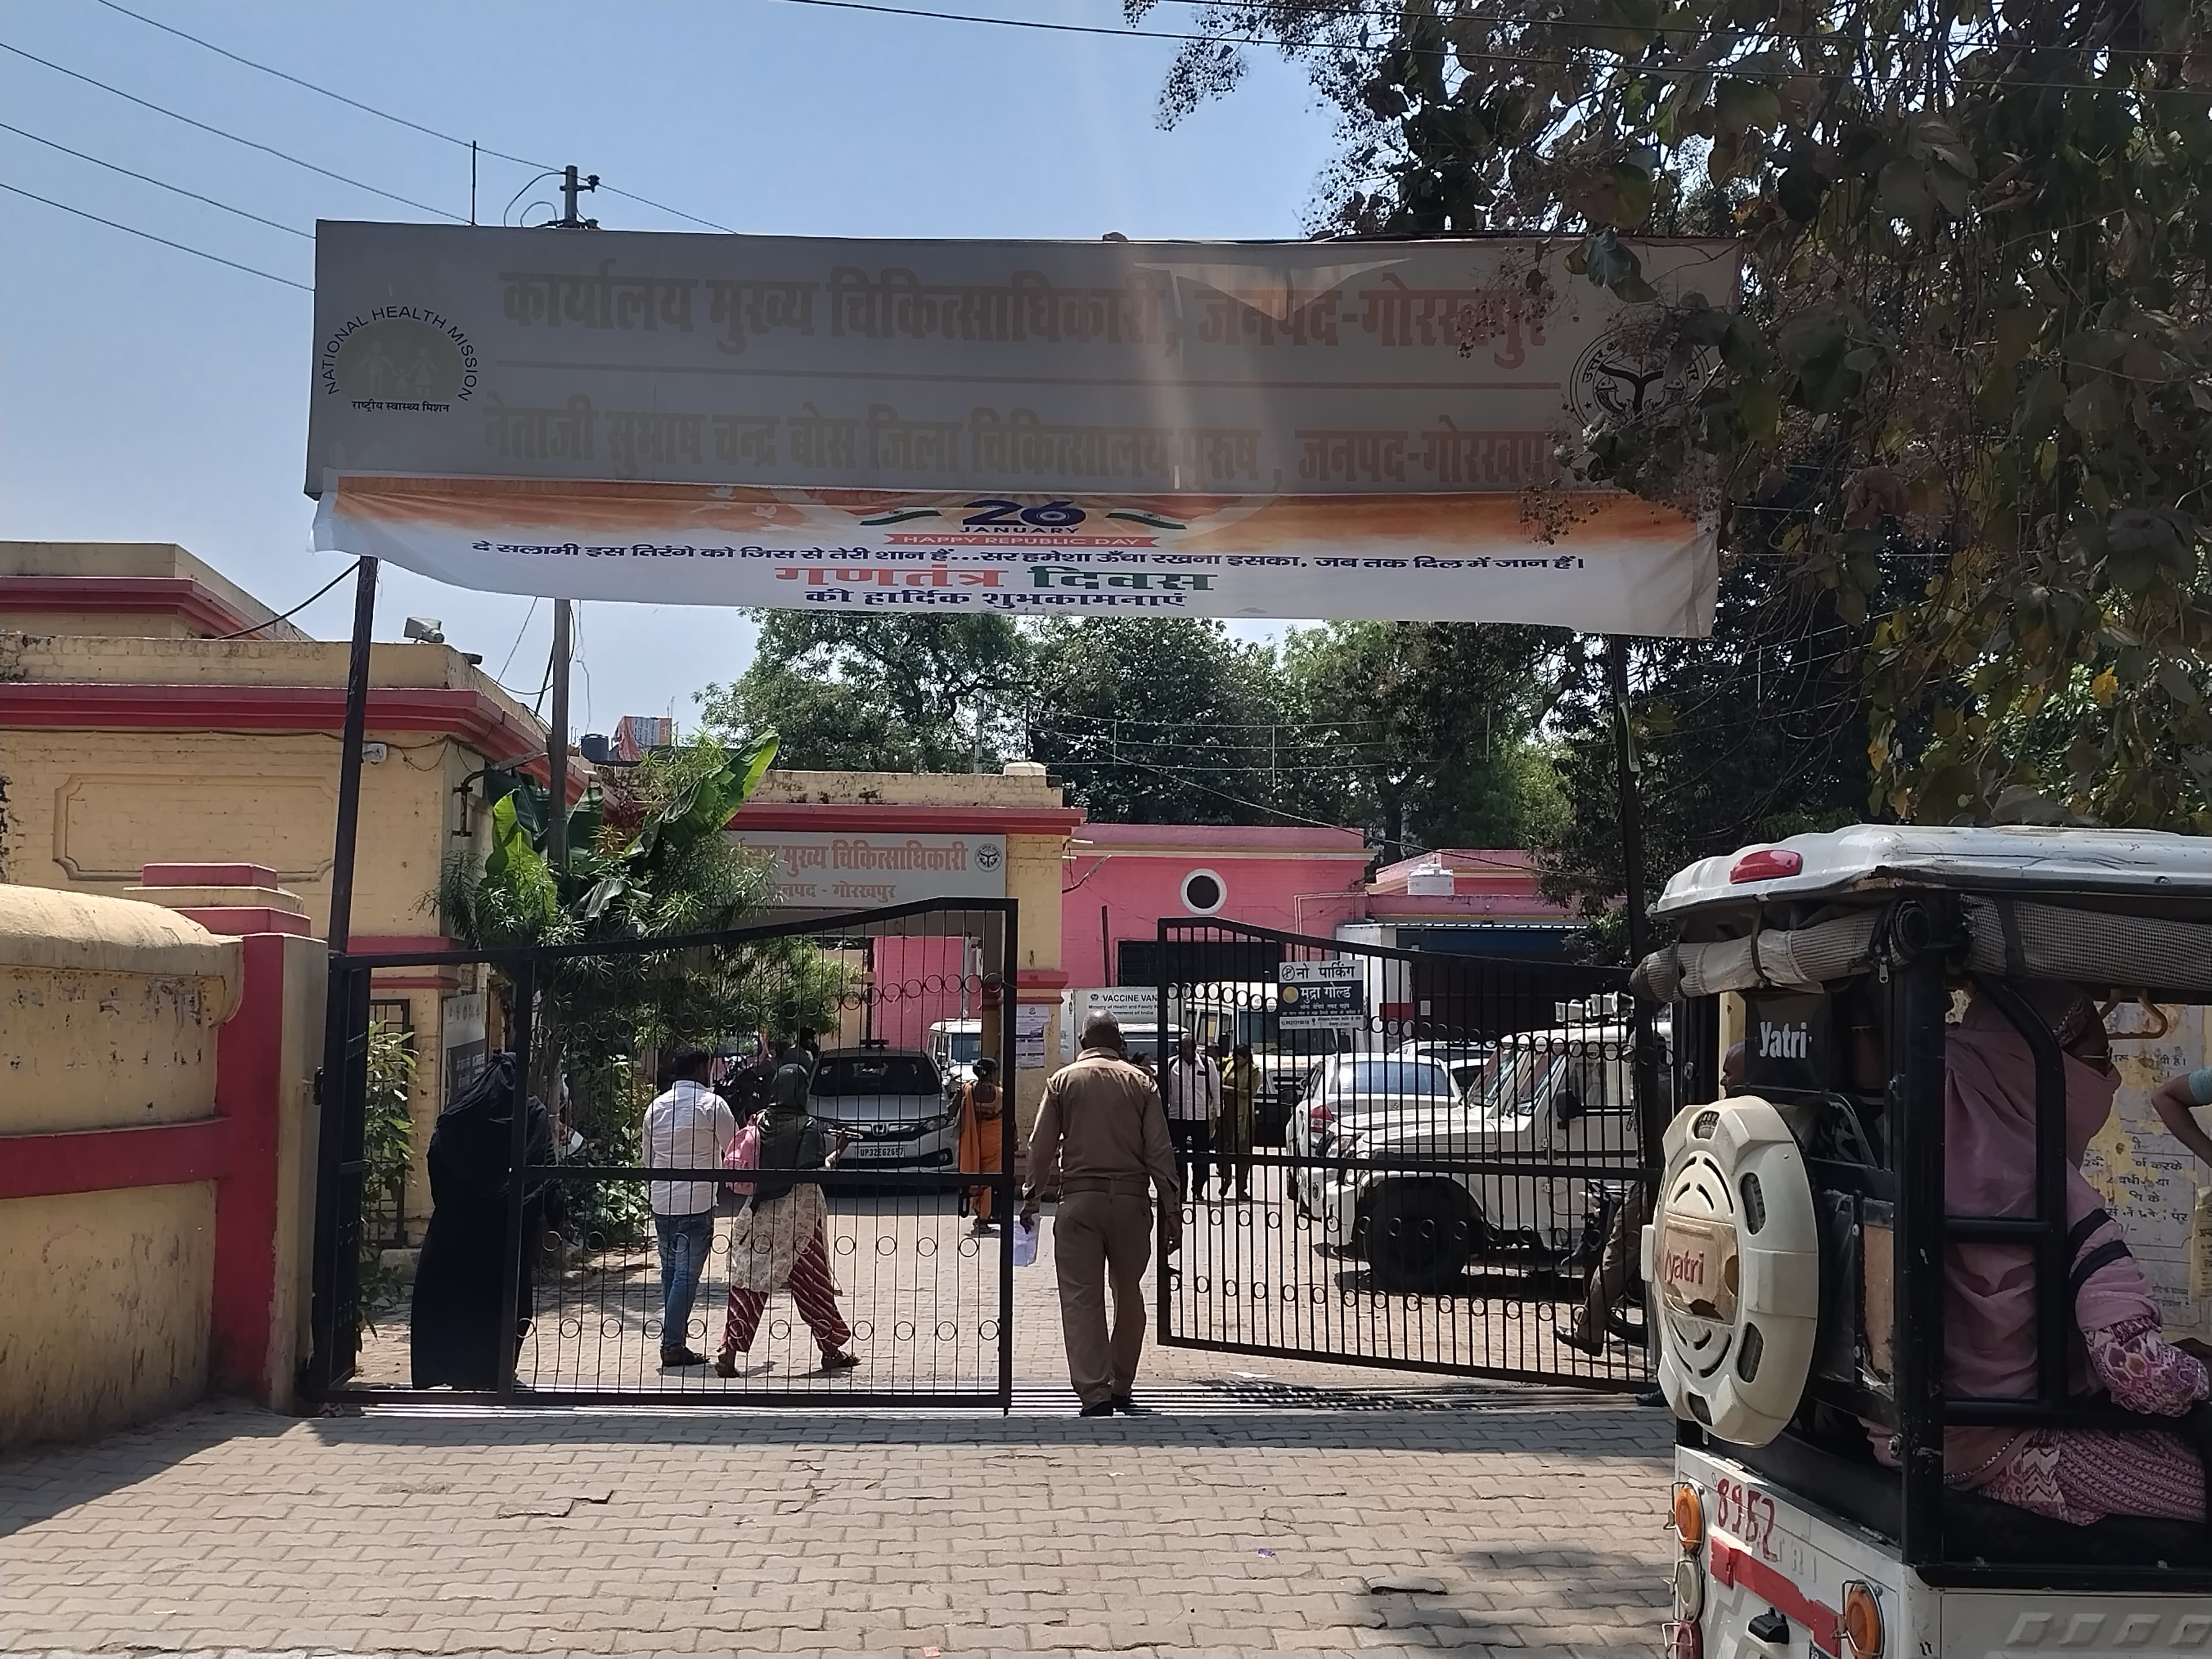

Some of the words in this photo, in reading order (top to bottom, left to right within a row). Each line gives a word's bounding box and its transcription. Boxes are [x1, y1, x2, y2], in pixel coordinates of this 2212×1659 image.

[498, 257, 699, 332] कार्यालय
[704, 278, 820, 355] मुख्य
[321, 315, 369, 396] NATIONAL
[370, 305, 448, 329] HEALTH
[446, 325, 478, 402] MISSION
[351, 398, 384, 412] राष्ट्रीय
[385, 402, 419, 412] स्वास्थ्य
[422, 401, 450, 413] मिशन
[482, 389, 599, 461] नेताजी
[605, 411, 706, 480] सुभाष
[712, 414, 781, 469] चन्द्र
[787, 401, 860, 470] बोस
[866, 403, 963, 474] जिला
[968, 406, 1174, 479] चिकित्सालय
[961, 499, 1086, 527] 26
[903, 536, 978, 544] HAPPY
[984, 536, 1086, 546] REPUBLIC
[1094, 538, 1140, 546] DAY
[959, 527, 1080, 535] JANUARY
[472, 540, 493, 552] दे
[497, 543, 582, 556] सलामी
[585, 546, 627, 558] इस
[631, 544, 696, 558] तिरंगे
[700, 546, 736, 559] को
[740, 546, 797, 559] जिस
[800, 547, 825, 560] से
[829, 545, 871, 560] तेरी
[875, 550, 925, 561] शान
[1021, 550, 1092, 563] हमेशा
[1152, 554, 1222, 566] रखना
[1313, 556, 1359, 569] जब
[1362, 556, 1409, 569] तक
[1412, 555, 1463, 569] दिल
[1466, 556, 1491, 568] में
[1493, 559, 1550, 569] जान
[774, 563, 1009, 588] गणतंत्र
[1027, 565, 1218, 590] दिवस
[804, 588, 855, 603] की
[863, 589, 972, 606] हार्दिक
[781, 844, 830, 878] मुख्य
[832, 839, 969, 872] चिकित्साधिकारी
[769, 883, 817, 898] नपद
[832, 880, 897, 903] गोरखपुर
[1296, 963, 1310, 979] नो
[1319, 961, 1355, 979] पार्किंग
[1300, 987, 1321, 1003] मुद्रा
[1324, 982, 1352, 999] गोल्ड
